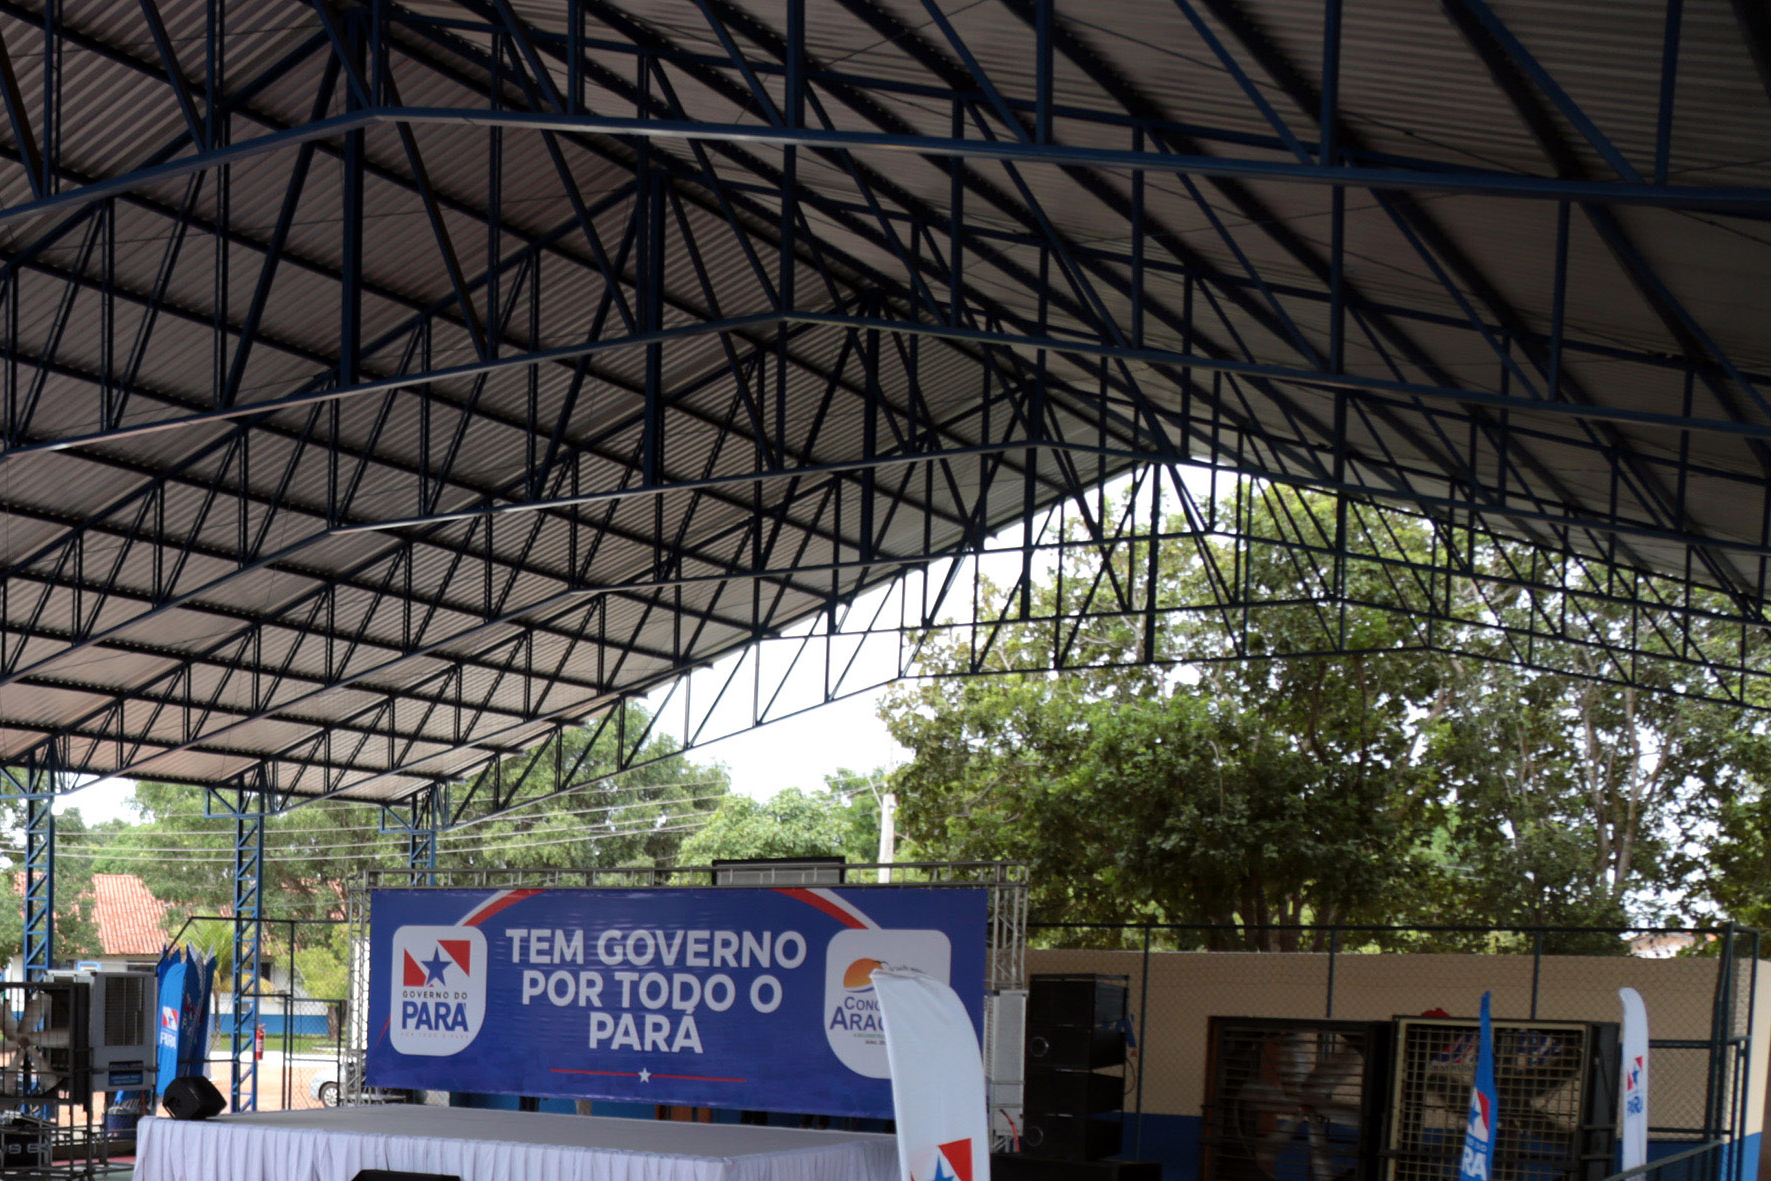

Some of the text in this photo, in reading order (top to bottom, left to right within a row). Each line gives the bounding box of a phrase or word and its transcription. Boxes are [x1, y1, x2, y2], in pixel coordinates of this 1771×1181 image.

[505, 928, 807, 969] TEM GOVERNO
[402, 990, 468, 1000] GOVERNO DO
[522, 969, 783, 1013] POR TODO O
[589, 1007, 704, 1054] PARÁ
